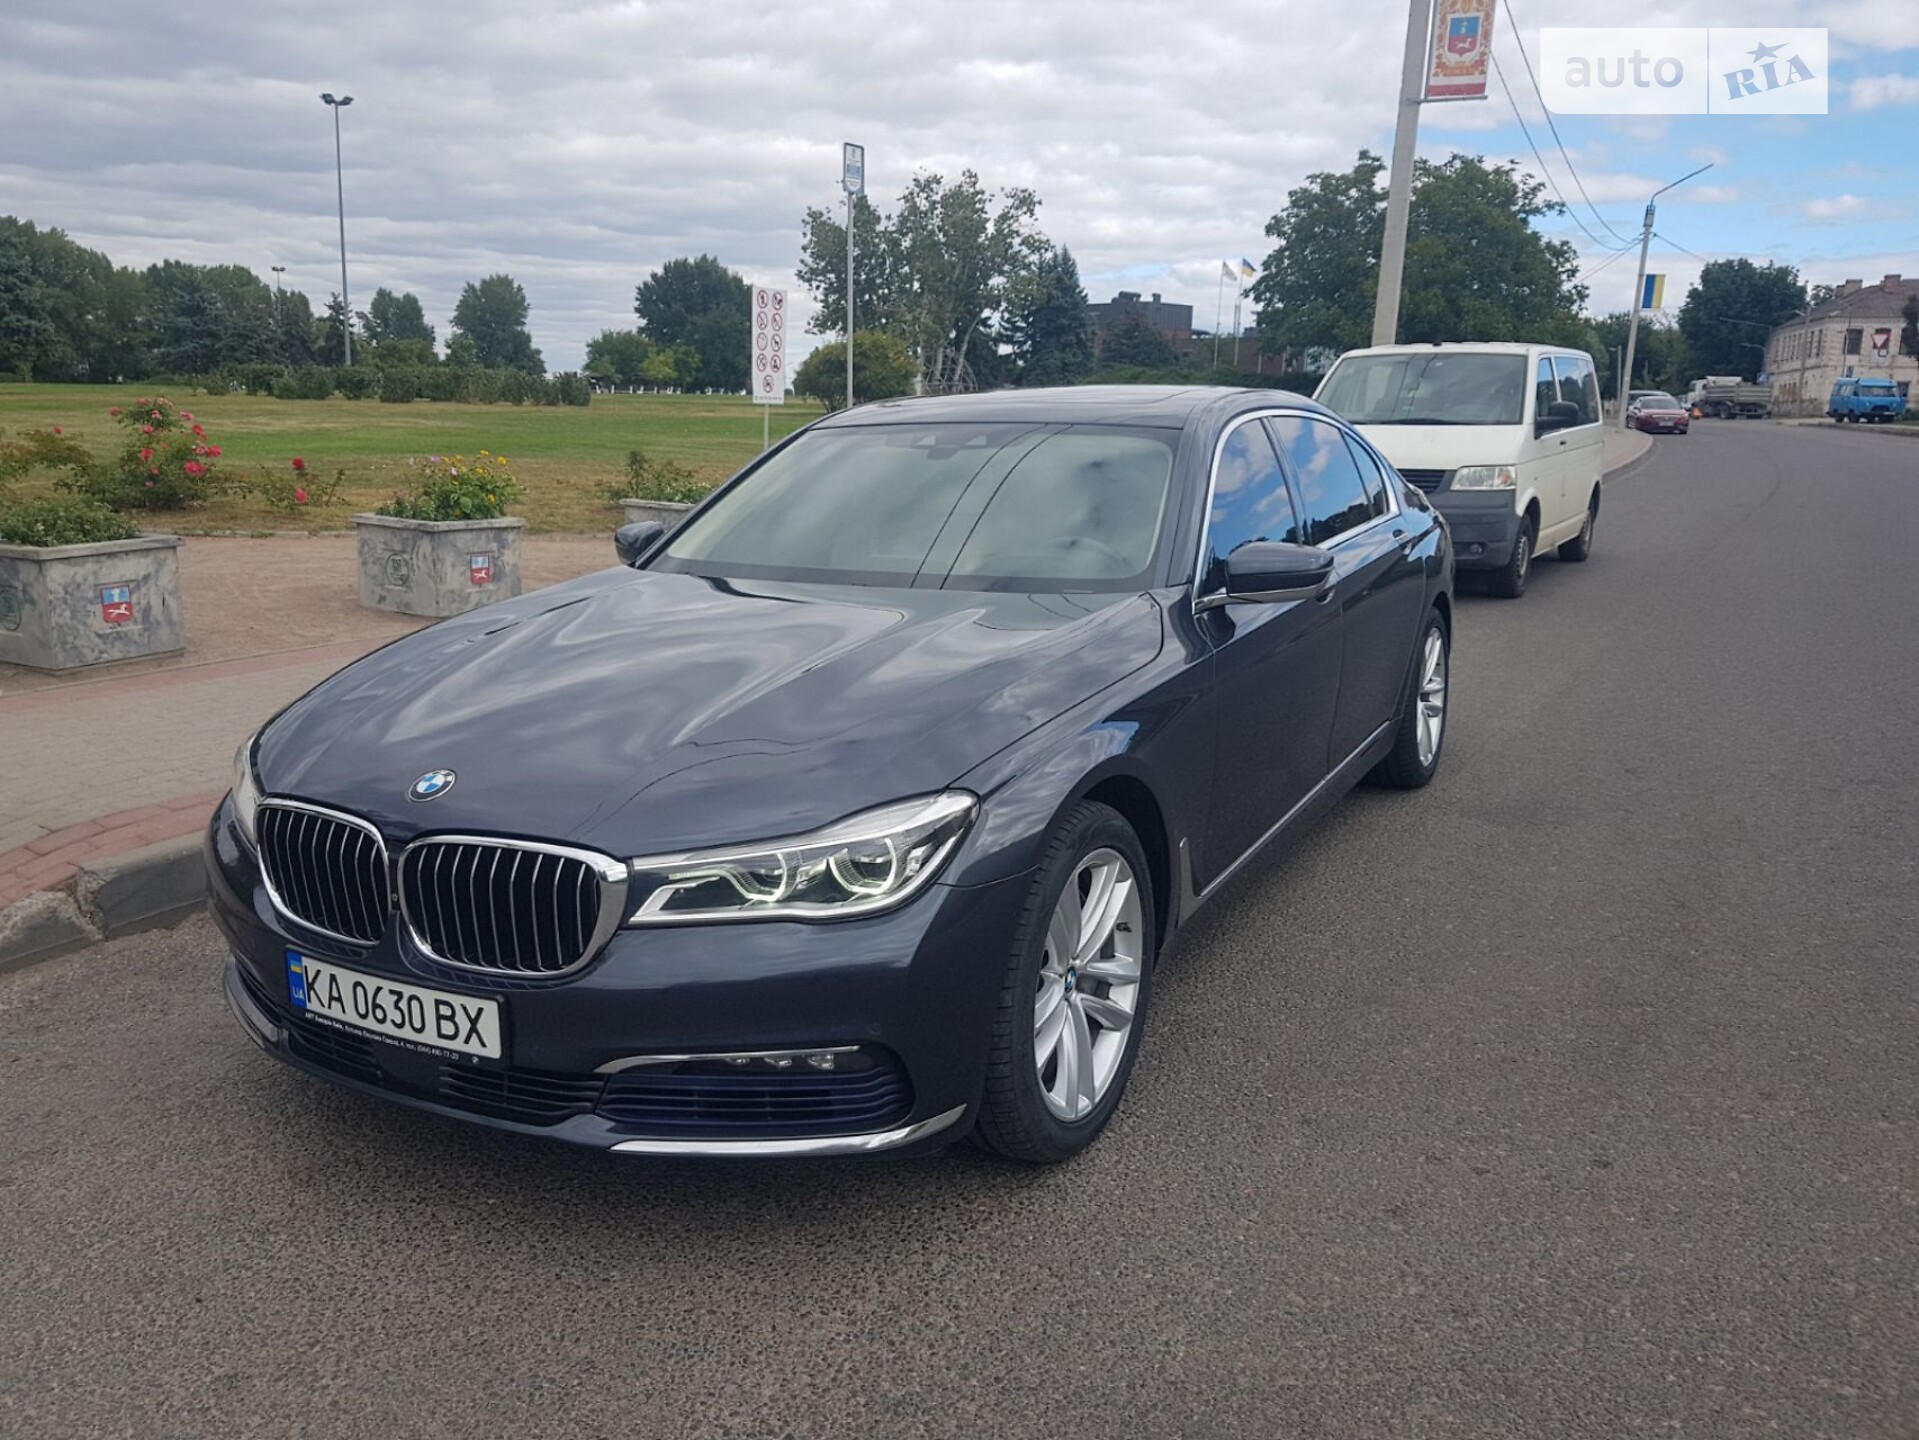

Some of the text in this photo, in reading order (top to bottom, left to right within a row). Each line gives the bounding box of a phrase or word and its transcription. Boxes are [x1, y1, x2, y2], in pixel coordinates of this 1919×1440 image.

[292, 986, 305, 1000] UA
[304, 965, 488, 1049] KA 0630 BX
